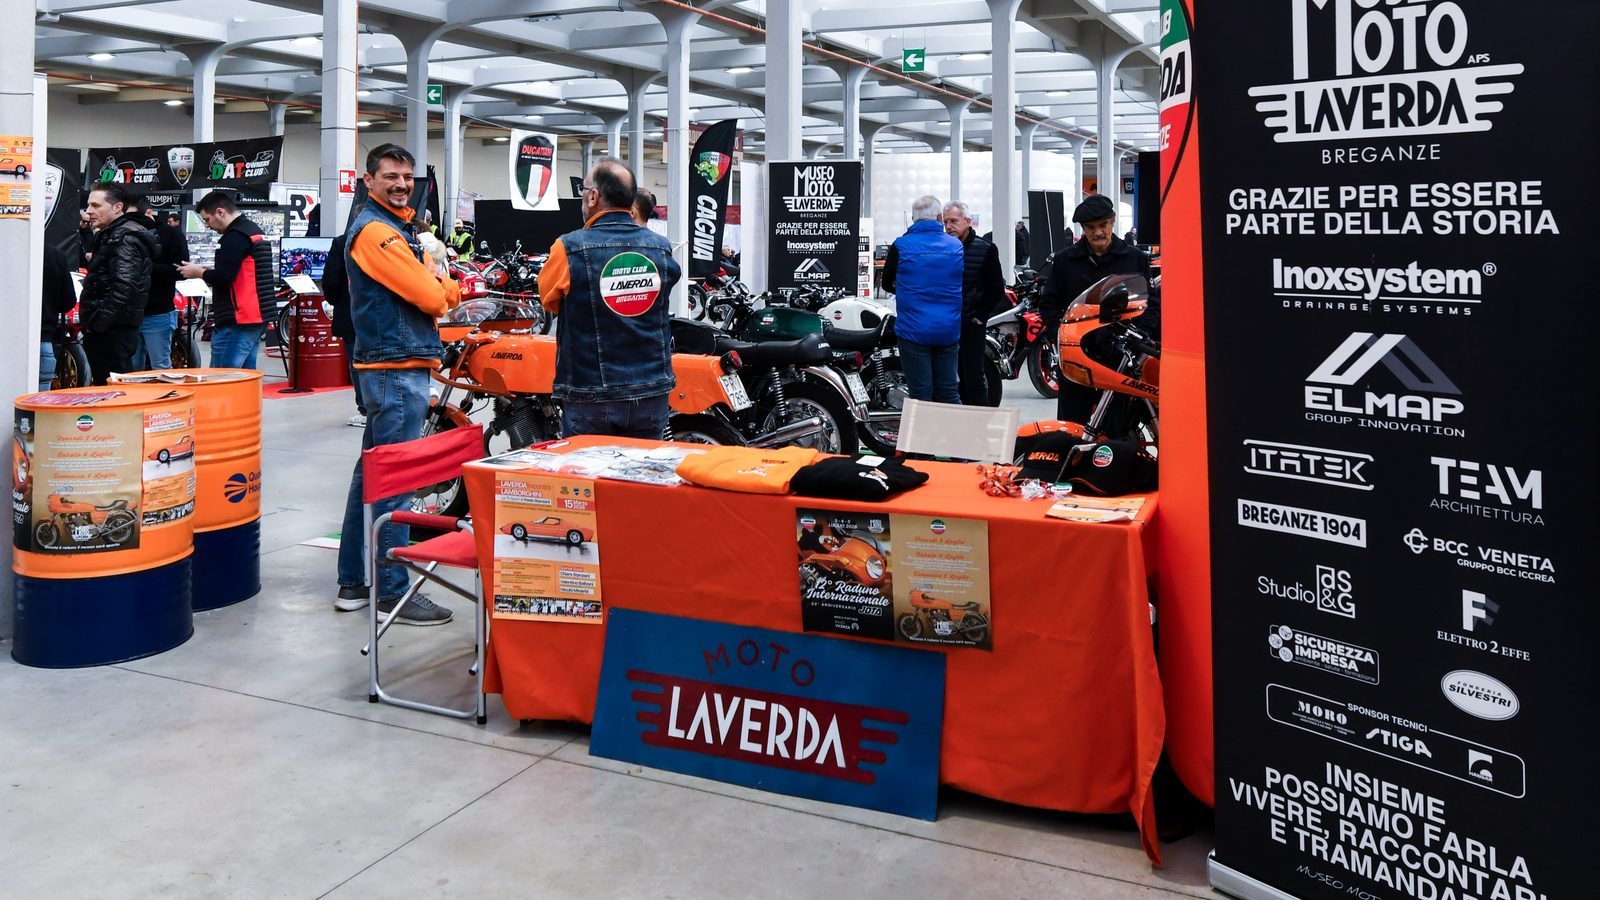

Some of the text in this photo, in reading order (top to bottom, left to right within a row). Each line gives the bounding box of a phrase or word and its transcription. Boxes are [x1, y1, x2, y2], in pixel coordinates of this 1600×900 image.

[1467, 53, 1491, 65] APS
[1294, 77, 1469, 134] LAVERDA
[245, 160, 270, 168] OWNERS
[1321, 144, 1441, 164] BREGANZE
[101, 168, 134, 183] DAT
[134, 175, 153, 183] CLUB
[211, 162, 245, 179] DAT
[245, 168, 264, 177] CLUB
[794, 198, 833, 210] LAVERDA
[1228, 180, 1543, 210] GRAZIE PER ESSERE
[693, 194, 717, 262] CAGIVA
[1226, 209, 1560, 235] PARTE DELLA STORIA
[612, 265, 648, 275] MOTO CLUB
[610, 278, 653, 291] LAVERDA
[616, 293, 648, 303] BREGANZE
[1283, 300, 1472, 316] DRAINAGE SYSTEMS
[491, 352, 523, 361] LAVERDA
[1304, 385, 1465, 422] ELMAP
[1305, 412, 1465, 438] GROUP INNOVATION
[1430, 456, 1543, 510] TEAM
[1242, 504, 1361, 541] BREGANZE 1904
[1429, 498, 1545, 526] ARCHITETTURA
[1433, 537, 1555, 573] BCC VENETA
[1457, 558, 1556, 584] GRUPPO BCC ICCREA
[806, 587, 890, 607] Internazionale
[835, 580, 880, 596] Raduno
[1258, 575, 1316, 604] Studio
[858, 605, 882, 616] JOTA
[1294, 633, 1375, 665] SICUREZZA
[1437, 630, 1530, 661] ELETTRO 2 EFFE
[703, 640, 815, 687] MOTO
[1294, 645, 1360, 673] IMPRESA
[1449, 684, 1511, 708] SILVESTRI
[1457, 681, 1502, 696] FONDERIA
[1298, 700, 1348, 725] MORO
[1347, 703, 1428, 733] SPONSOR TECNICI
[668, 686, 846, 768] LAVERDA
[1365, 728, 1432, 759] STIGA
[1326, 761, 1446, 825] INSIEME
[1229, 777, 1330, 839] VIVERE,
[1265, 766, 1533, 886] POSSIAMO FARLA
[1271, 817, 1287, 845] E
[1296, 865, 1344, 889] MUSEO
